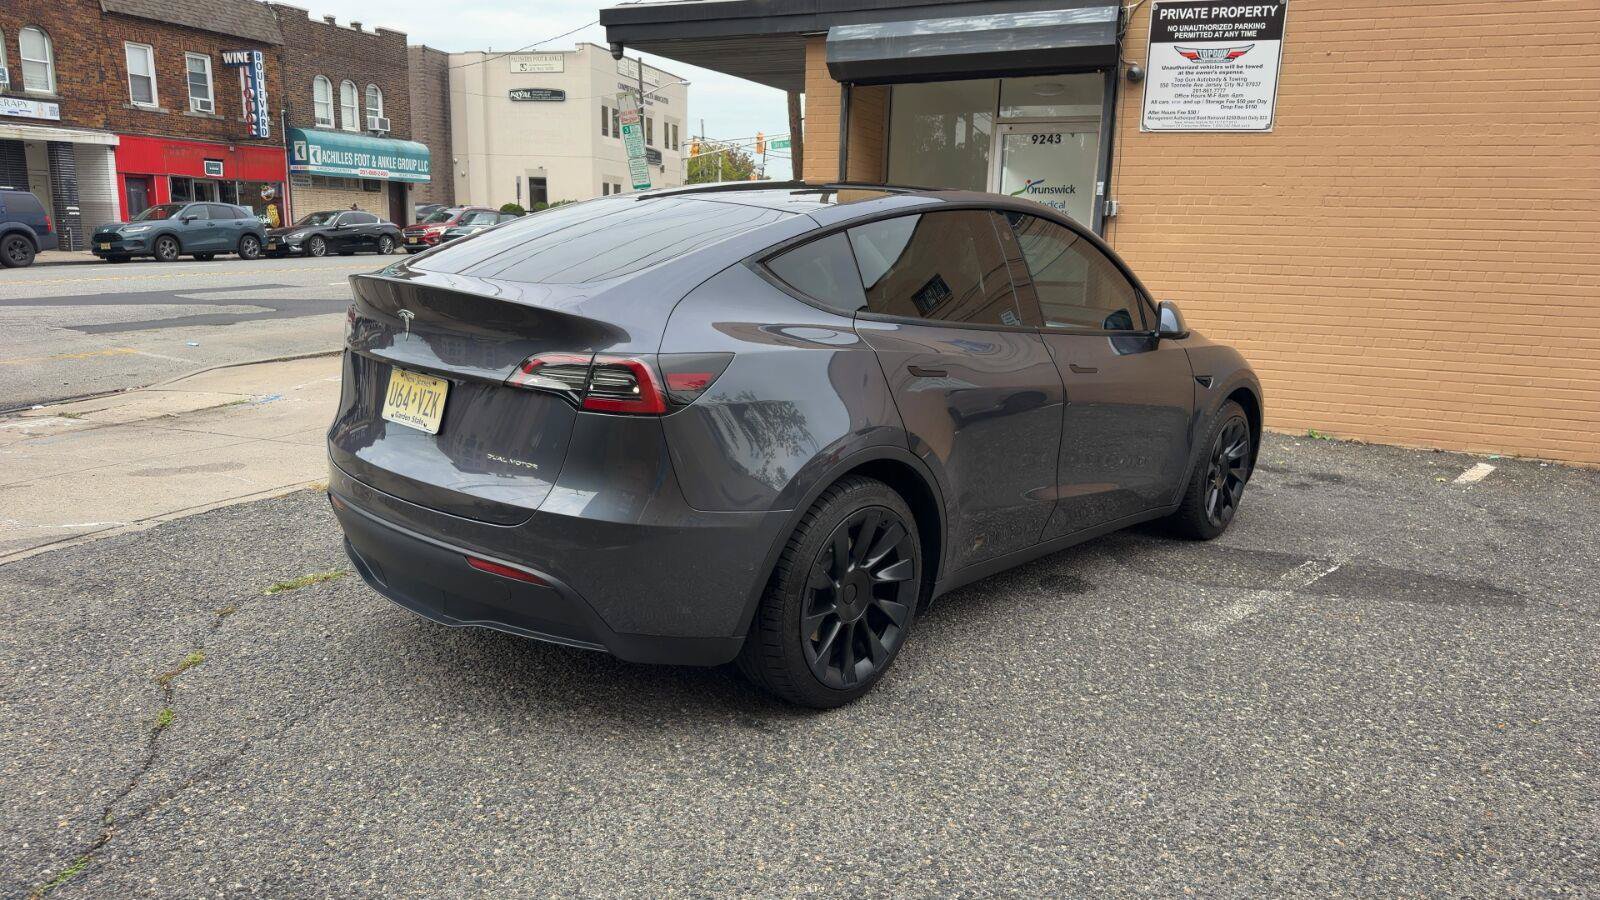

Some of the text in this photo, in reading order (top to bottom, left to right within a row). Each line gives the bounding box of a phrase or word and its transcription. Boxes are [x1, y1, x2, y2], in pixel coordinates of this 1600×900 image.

[1160, 5, 1278, 20] PRIVATE PROPERTY
[1174, 31, 1213, 39] PERMITTED
[1224, 30, 1238, 38] ANY
[1179, 23, 1233, 32] UNAUTHORIZED
[1234, 22, 1266, 30] PARKING
[223, 52, 252, 64] WINE
[255, 52, 268, 137] BOULEVARD
[1031, 133, 1062, 145] 9243
[321, 150, 429, 173] ACHILLES FOOT & ANKLE GROUP LLC
[395, 411, 424, 426] Garden State
[487, 453, 539, 470] DUAL MOTOR
